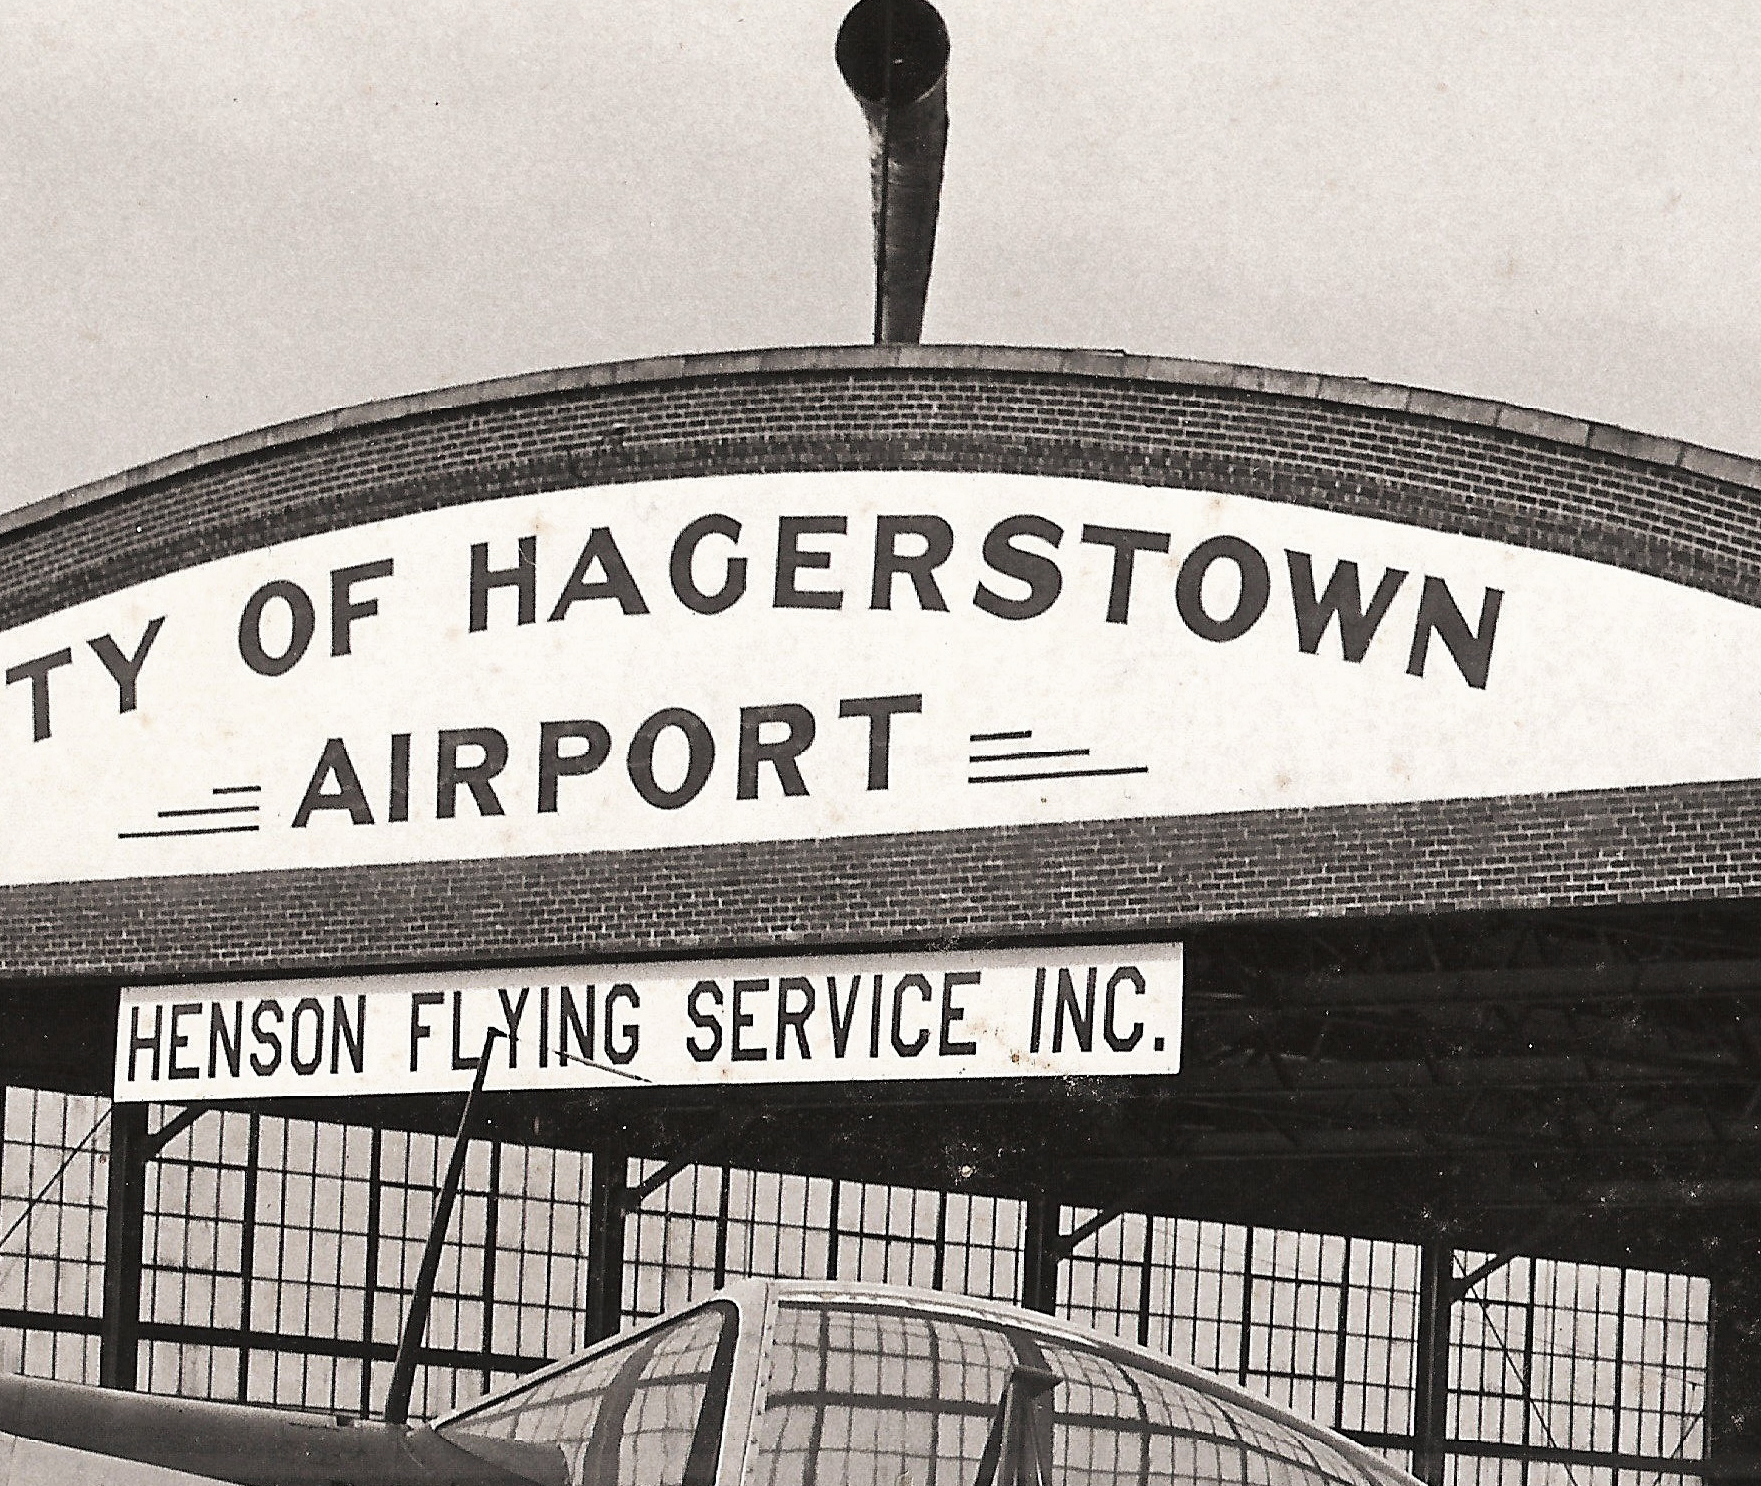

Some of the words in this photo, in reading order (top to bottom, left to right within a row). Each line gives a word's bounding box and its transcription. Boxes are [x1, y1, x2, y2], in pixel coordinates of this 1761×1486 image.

[238, 557, 394, 677] OF
[468, 513, 1505, 691] HAGERSTOWN
[290, 693, 923, 829] AIRPORT
[125, 994, 367, 1082] HENSON
[409, 983, 642, 1074] FLYING
[686, 970, 982, 1063] SERVICE
[1029, 965, 1164, 1054] INC.
